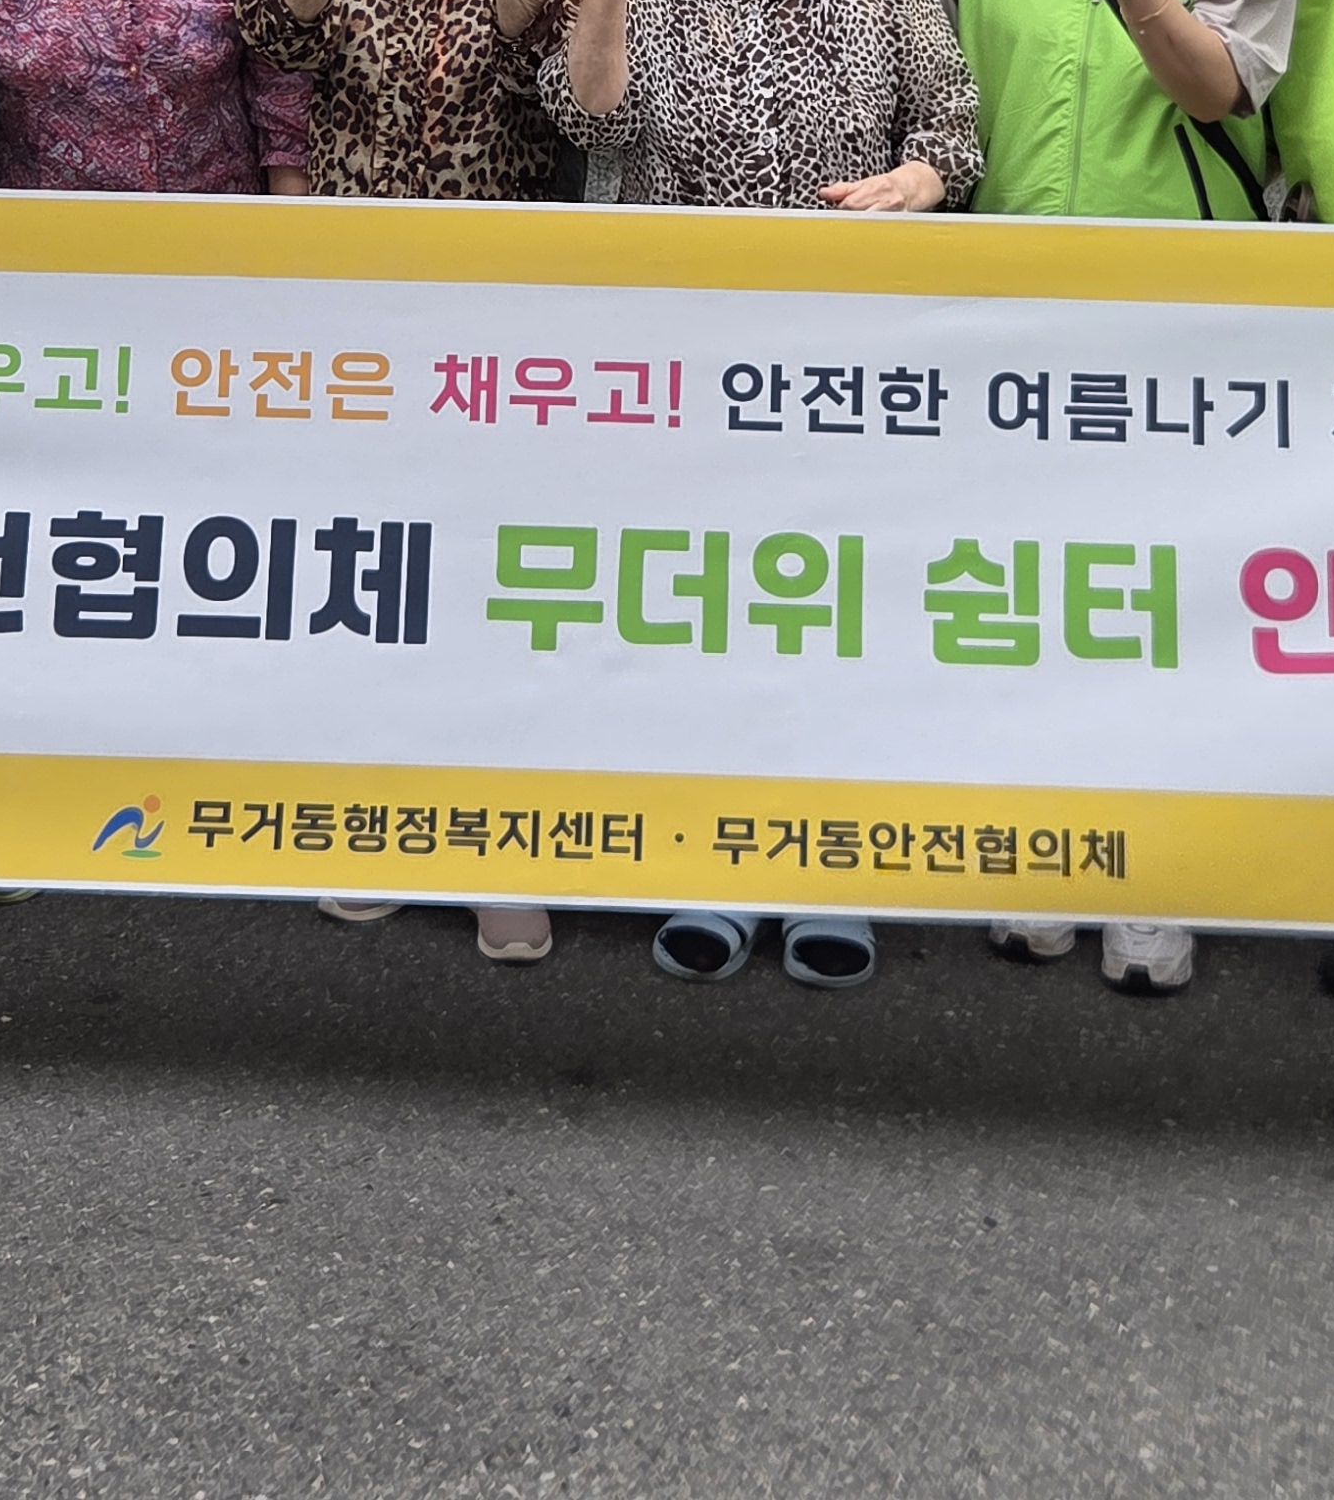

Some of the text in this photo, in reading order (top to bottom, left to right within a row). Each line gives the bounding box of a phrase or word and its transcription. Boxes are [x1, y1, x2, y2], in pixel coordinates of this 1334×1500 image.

[171, 348, 395, 420] 안전은
[430, 354, 683, 428] 채우고!
[721, 362, 948, 438] 안전한
[987, 371, 1291, 449] 여름나기
[486, 523, 864, 658] 무더위
[924, 538, 1179, 669] 쉼터
[187, 799, 644, 863] 무거동행정복지센터
[712, 816, 1127, 880] 무거동안전협의체
